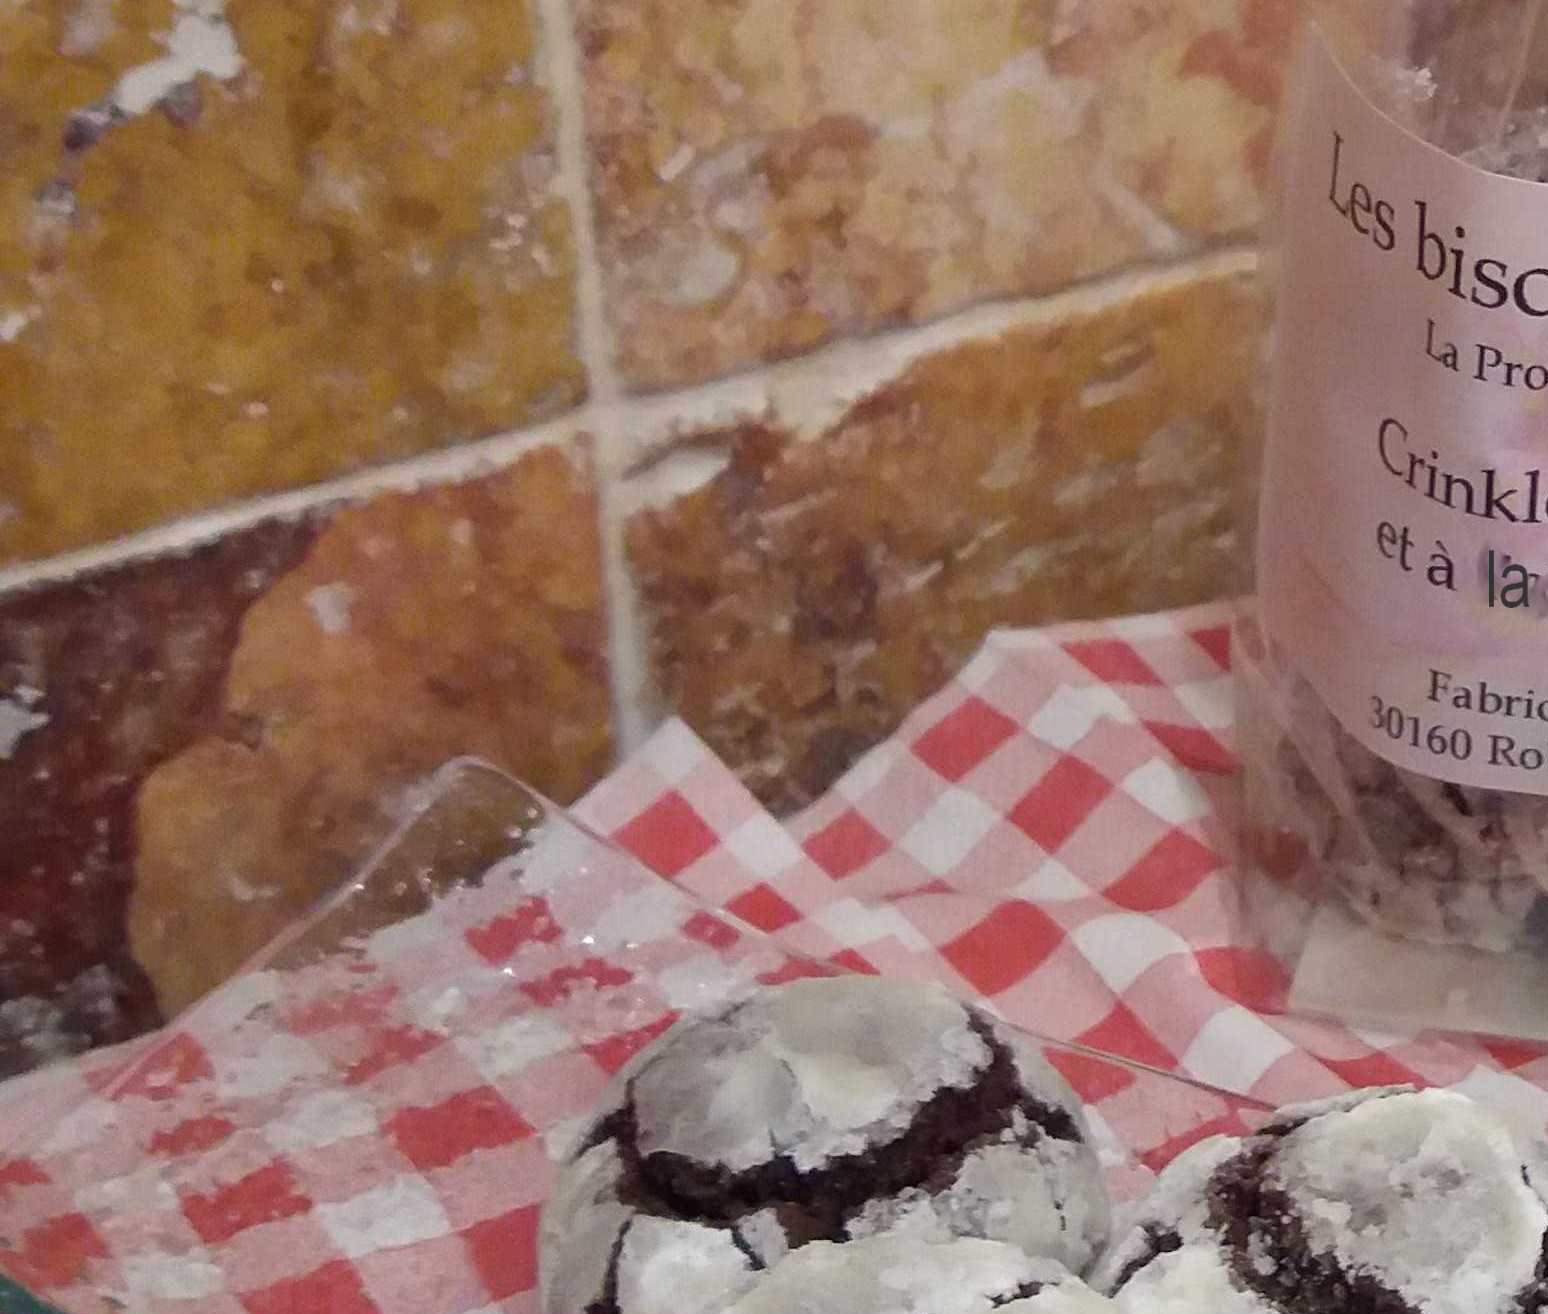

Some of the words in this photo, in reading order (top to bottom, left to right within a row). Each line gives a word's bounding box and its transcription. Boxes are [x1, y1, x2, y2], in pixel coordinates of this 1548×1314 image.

[1329, 131, 1396, 251] Les
[1424, 317, 1460, 373] La
[1376, 521, 1415, 572] et
[1426, 540, 1458, 592] à
[1367, 696, 1473, 761] 30160
